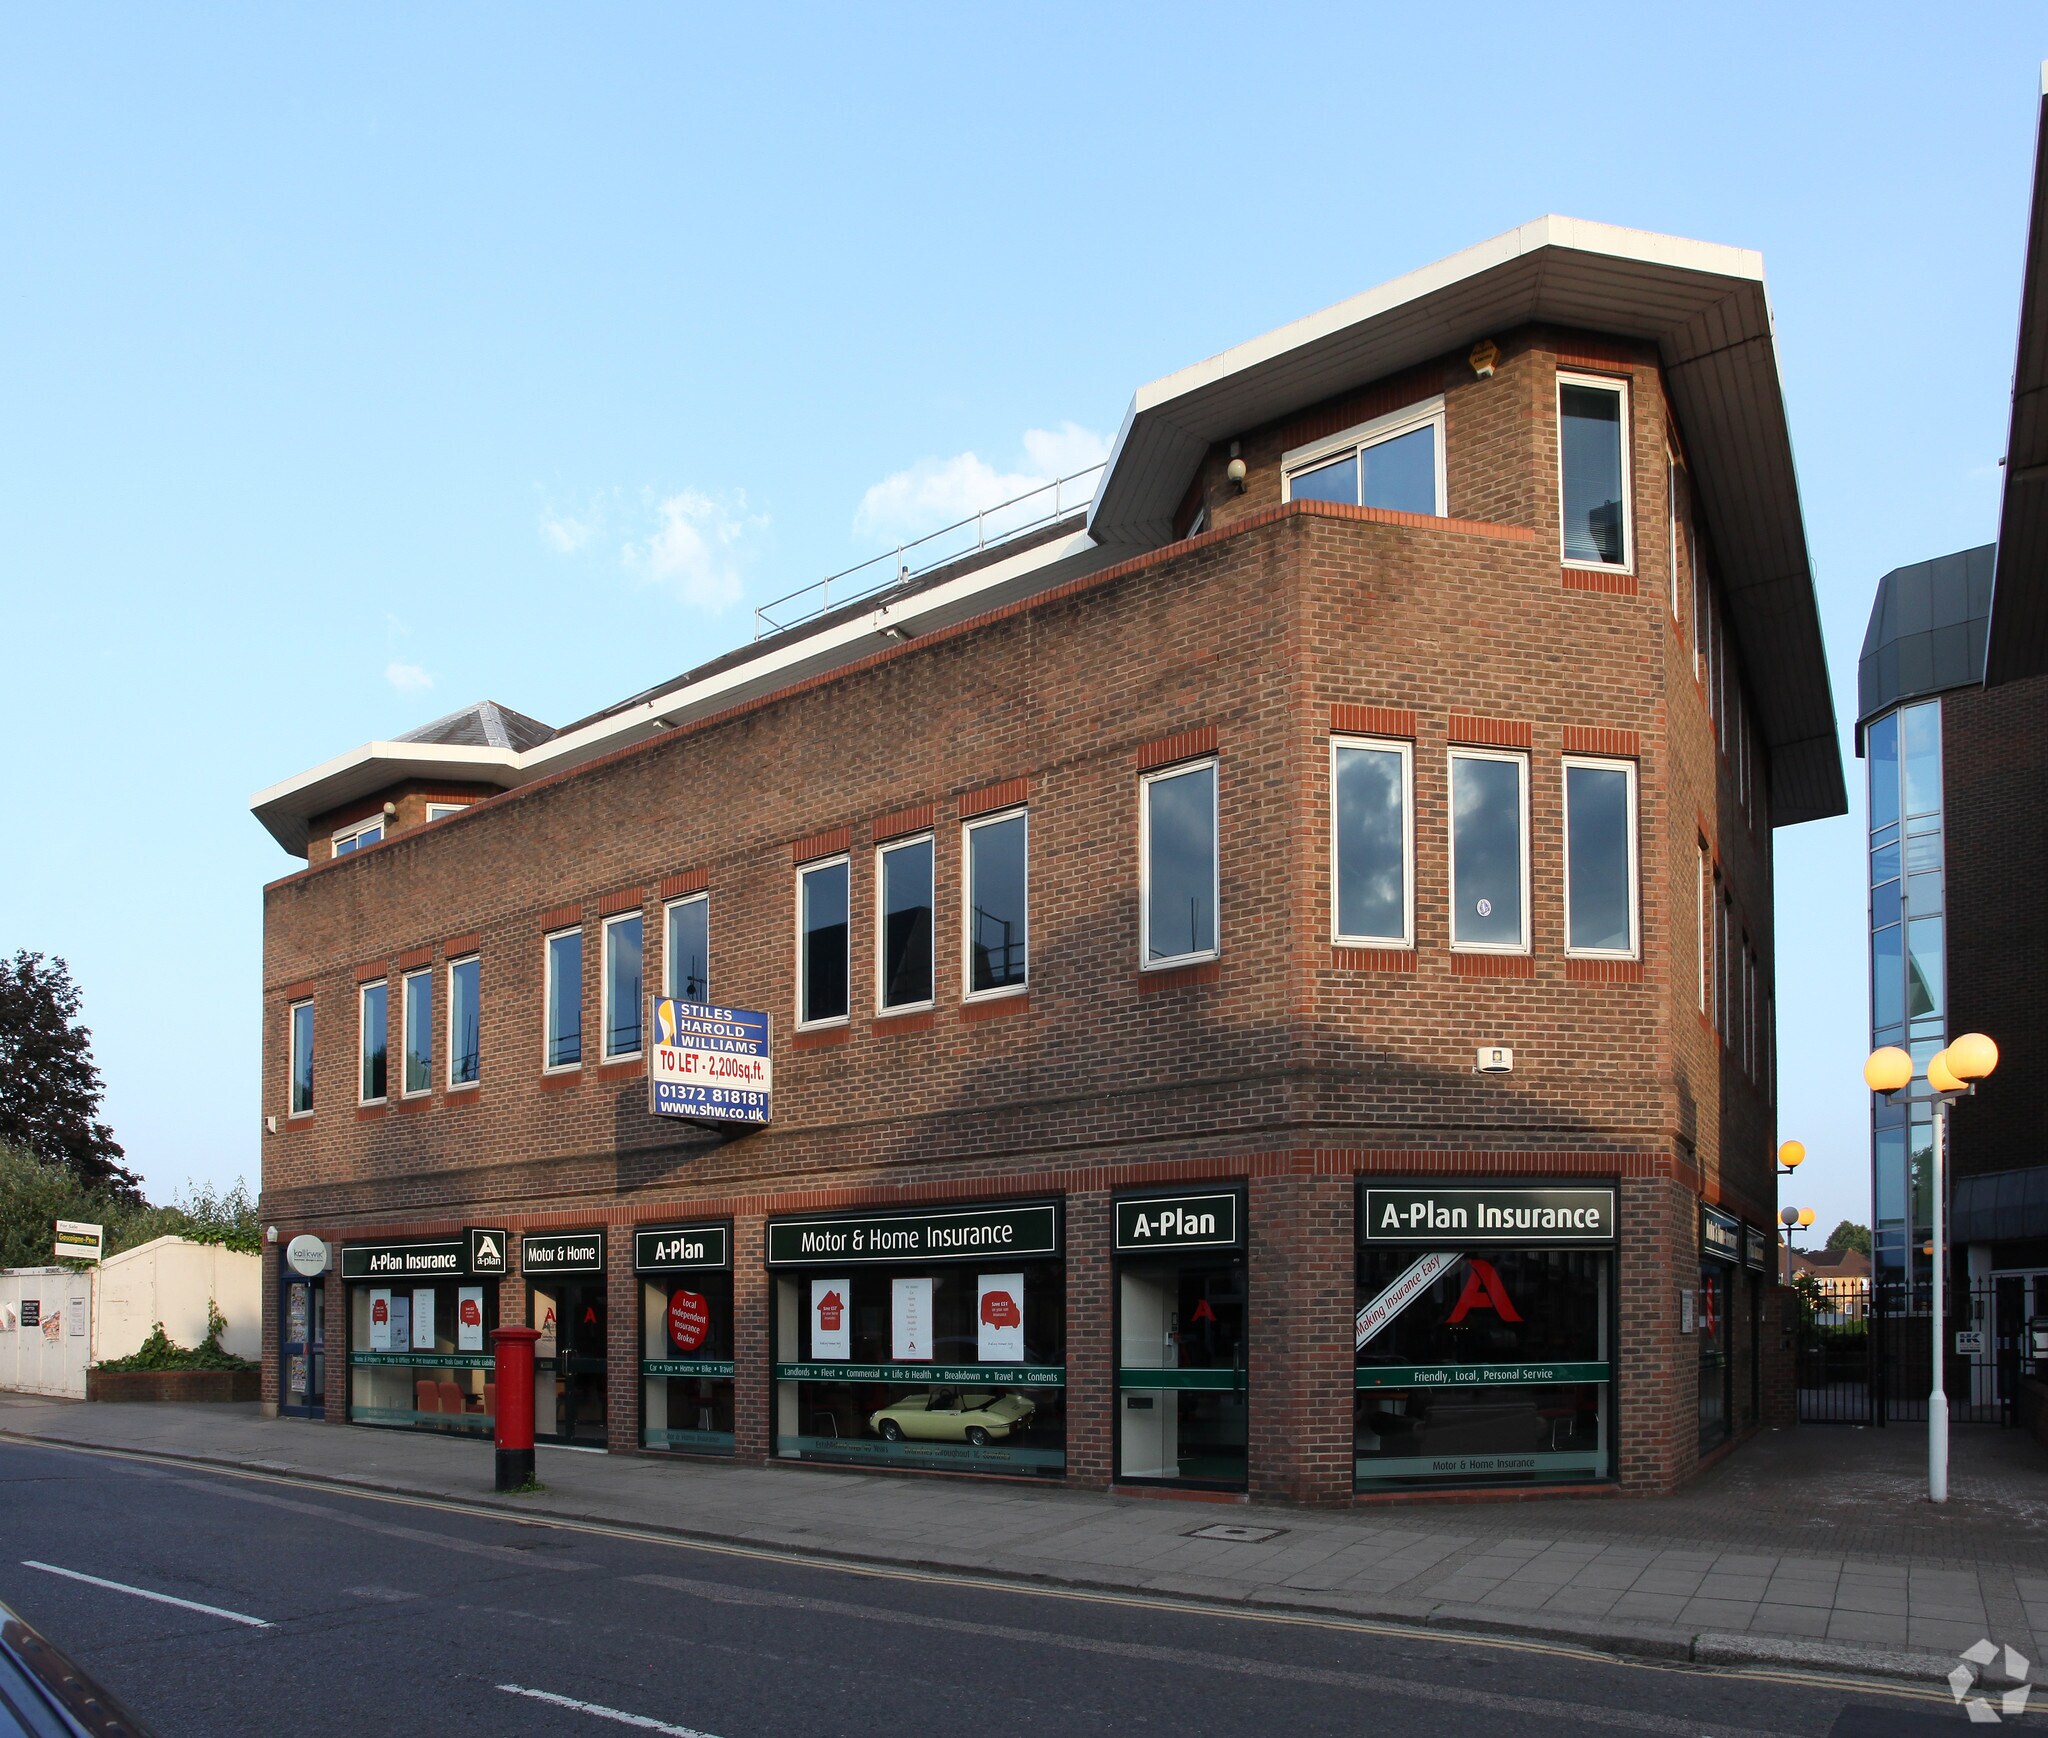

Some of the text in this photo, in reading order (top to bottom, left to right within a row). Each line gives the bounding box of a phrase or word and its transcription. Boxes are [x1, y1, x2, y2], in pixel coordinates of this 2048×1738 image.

[681, 1003, 732, 1021] STILES
[681, 1019, 745, 1037] HAROLD
[681, 1035, 757, 1054] WILLIAMS
[660, 1050, 675, 1071] TO
[678, 1052, 699, 1074] LET
[709, 1056, 764, 1083] 2,200sq.ft.
[659, 1084, 764, 1106] 01372 818181
[660, 1101, 764, 1121] www.shw.co.uk
[1133, 1207, 1215, 1238] A-Plan
[1381, 1200, 1599, 1229] A-Plan Insurance
[801, 1223, 1013, 1253] Motor & Home Insurance
[477, 1235, 501, 1258] A
[528, 1245, 595, 1262] Motor & Home
[655, 1238, 704, 1261] A-Plan
[370, 1252, 457, 1271] A-Plan Insurance
[477, 1256, 501, 1267] a-plan
[1356, 1255, 1443, 1337] Making Insurance Easy
[1445, 1258, 1524, 1323] A
[682, 1298, 697, 1309] Local
[672, 1307, 706, 1324] Independent
[674, 1319, 700, 1335] Insurance
[677, 1332, 695, 1345] Broker
[649, 1364, 658, 1372] Car
[664, 1364, 673, 1372] Van
[680, 1364, 694, 1373] Home
[702, 1364, 712, 1373] Bike
[719, 1365, 734, 1374] Travel
[784, 1367, 810, 1378] Landlords
[821, 1368, 835, 1377] Fleet
[846, 1368, 880, 1379] Commercial
[892, 1369, 903, 1379] Life
[911, 1370, 932, 1380] Health
[944, 1370, 980, 1381] Breakdown
[1414, 1368, 1553, 1384] Friendly, Local, Personal Service
[994, 1372, 1014, 1382] Travel
[1027, 1372, 1058, 1383] Contents
[1433, 1458, 1535, 1470] Motor & Home Insurance
